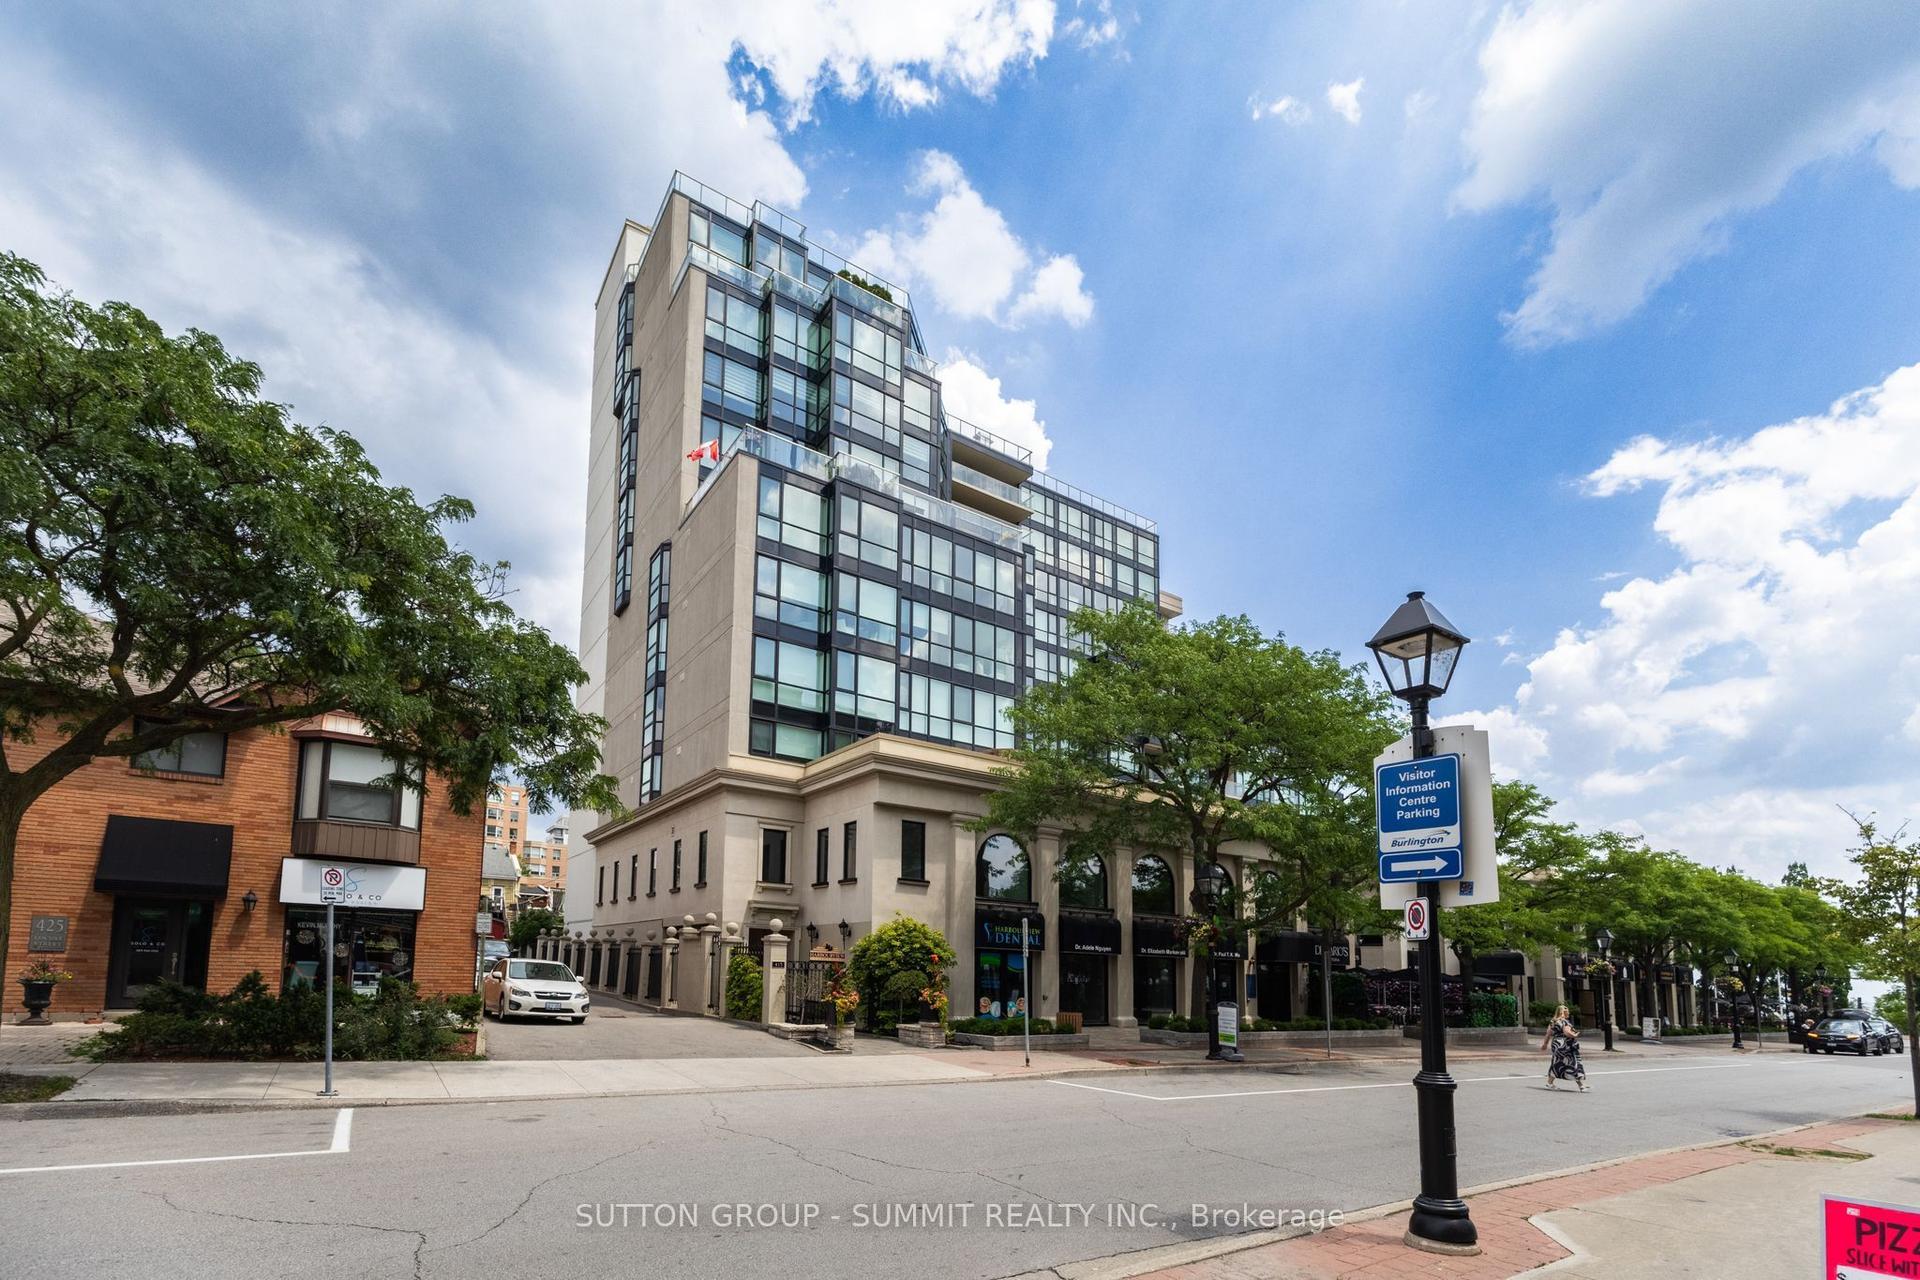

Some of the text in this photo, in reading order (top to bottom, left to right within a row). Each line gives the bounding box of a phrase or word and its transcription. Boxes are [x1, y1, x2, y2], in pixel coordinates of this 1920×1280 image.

[1399, 769, 1435, 782] Visitor
[1385, 780, 1451, 797] Information
[1399, 795, 1437, 807] Centre
[1396, 806, 1440, 820] Parking
[1391, 836, 1444, 847] Burlington
[36, 919, 64, 932] 425
[1846, 1248, 1886, 1271] SLICE
